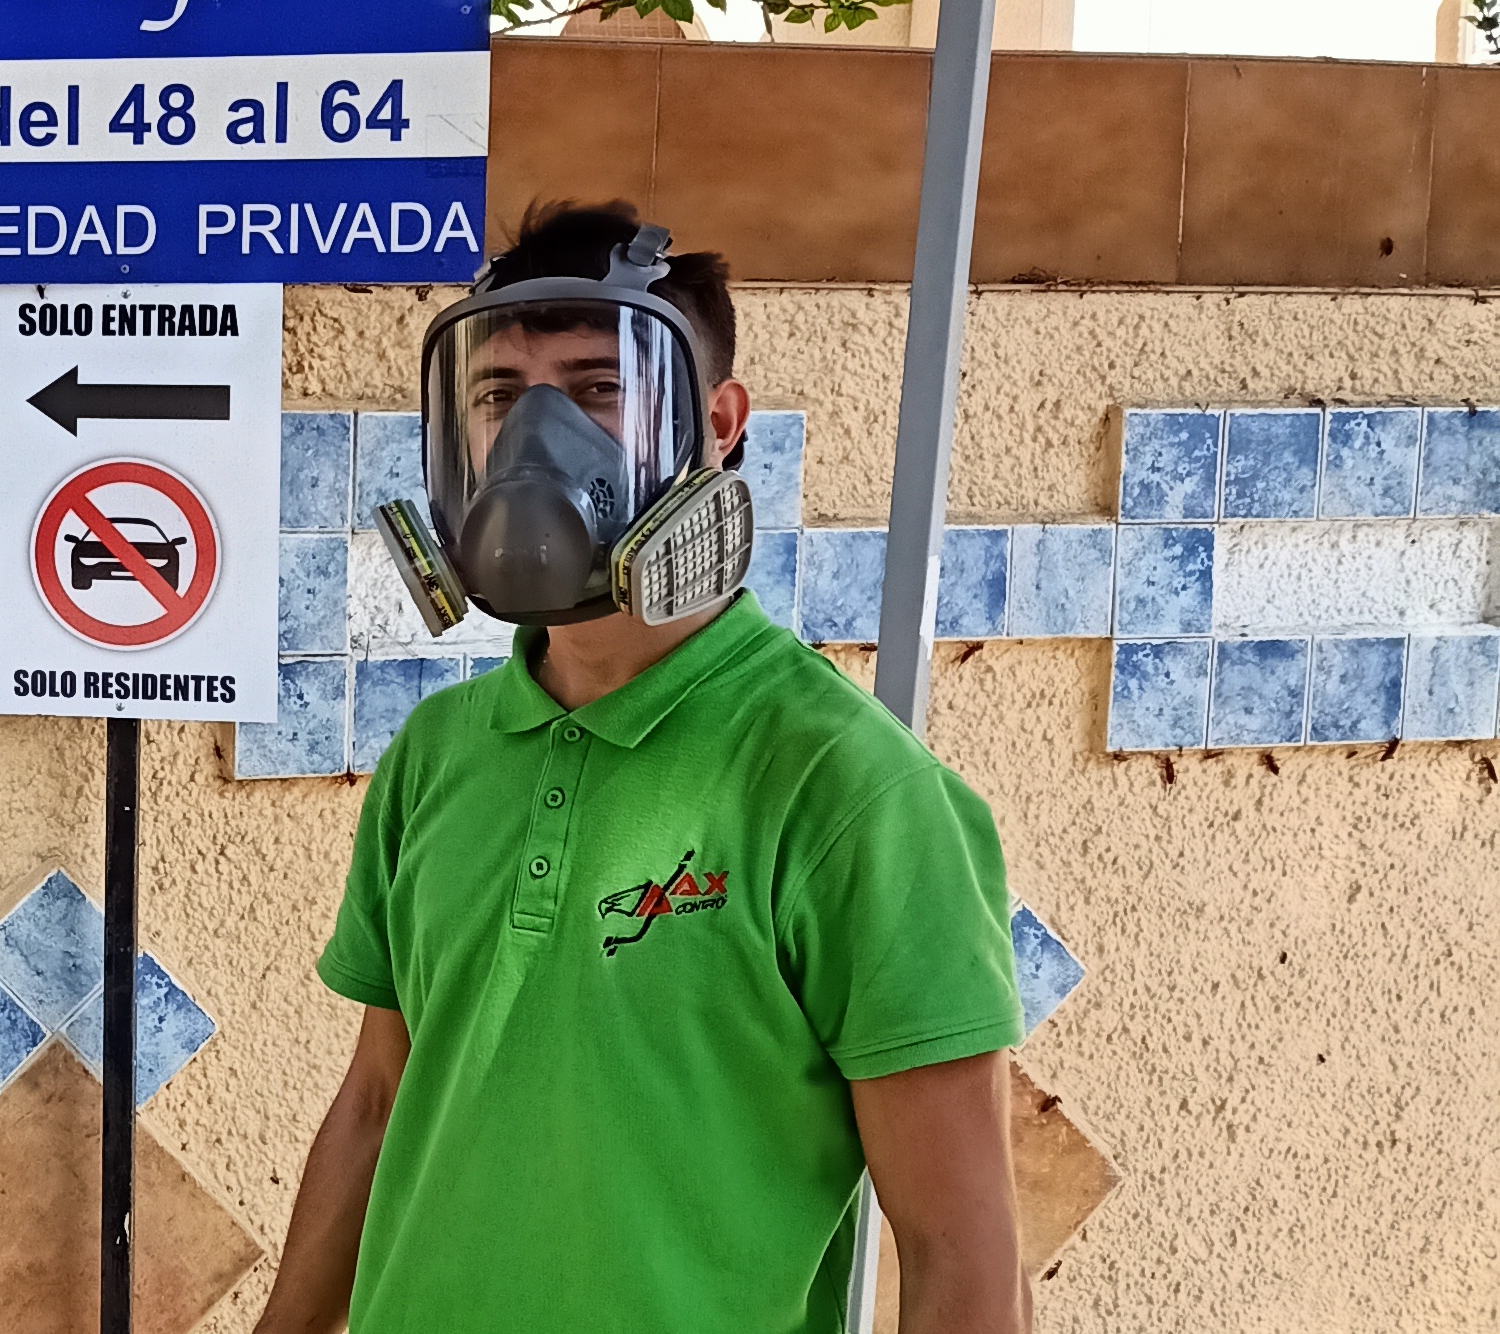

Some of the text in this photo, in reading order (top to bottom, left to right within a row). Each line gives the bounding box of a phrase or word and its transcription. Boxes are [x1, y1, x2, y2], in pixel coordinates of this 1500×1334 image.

[108, 83, 197, 146] 48
[225, 80, 289, 144] al
[319, 78, 411, 143] 64
[198, 201, 479, 255] PRIVADA
[18, 303, 240, 337] SOLO ENTRADA
[13, 669, 237, 704] SOLO RESIDENTES
[674, 894, 729, 916] CONTRO
